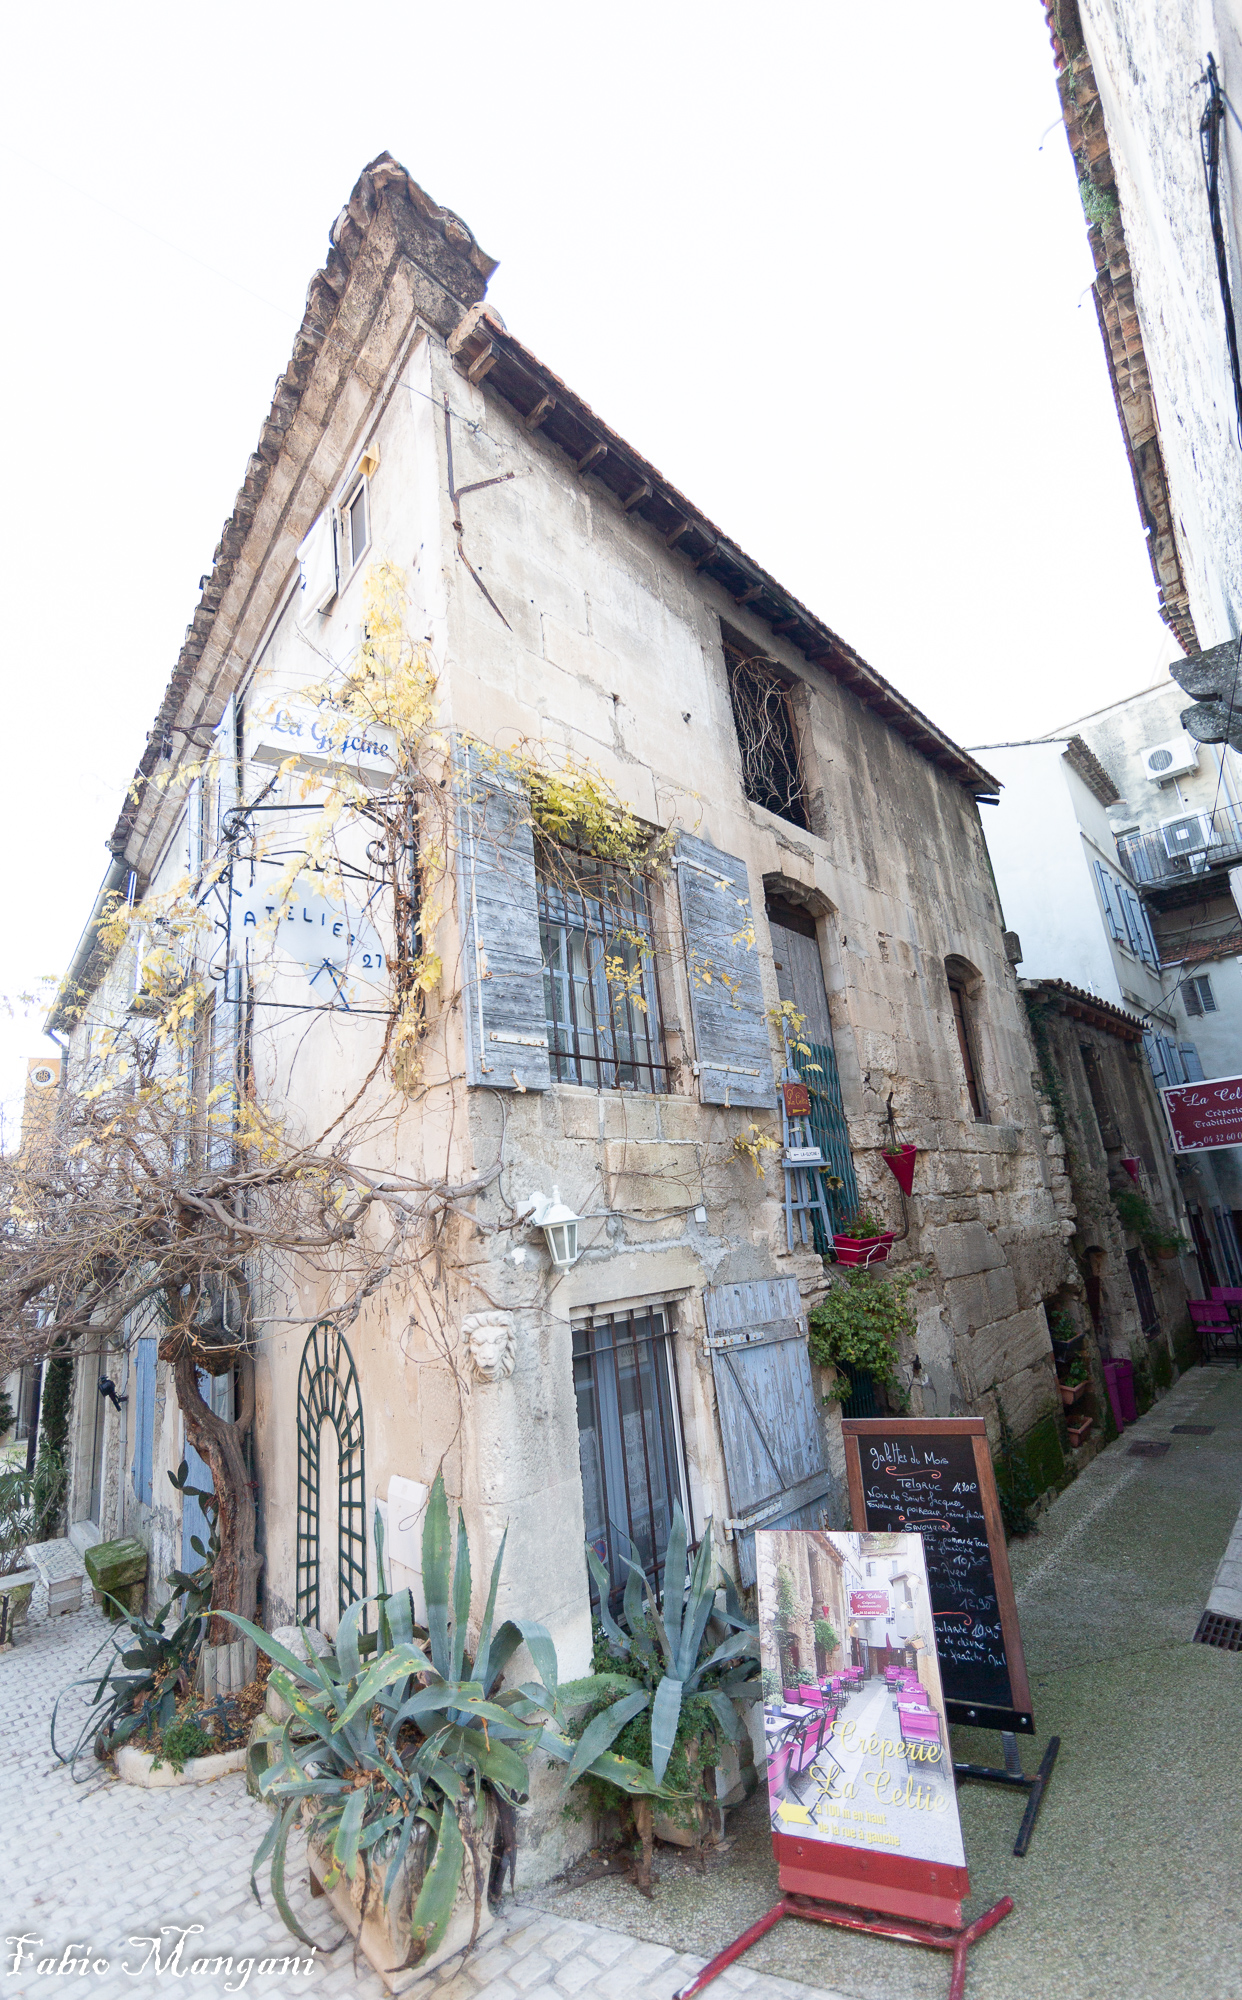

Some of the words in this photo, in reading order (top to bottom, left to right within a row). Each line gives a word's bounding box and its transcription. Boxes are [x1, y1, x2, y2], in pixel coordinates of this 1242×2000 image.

[271, 710, 303, 737] La
[311, 721, 389, 757] Gcine
[244, 905, 355, 946] ATELIER
[362, 954, 382, 968] 27
[1182, 1093, 1209, 1106] La
[1214, 1086, 1242, 1101] Cel
[1203, 1135, 1213, 1143] 04
[1215, 1133, 1224, 1142] 32
[1226, 1132, 1236, 1141] 60
[890, 1490, 901, 1502] de
[830, 1720, 944, 1769] Crêperie
[809, 1763, 859, 1799] La
[864, 1770, 950, 1813] Celtie
[824, 1803, 840, 1818] 100
[842, 1808, 851, 1820] m
[853, 1810, 864, 1822] en
[866, 1809, 887, 1825] haut
[818, 1820, 829, 1834] de
[831, 1822, 840, 1836] la
[842, 1826, 856, 1839] rue
[858, 1826, 865, 1841] à
[866, 1831, 900, 1847] gauche
